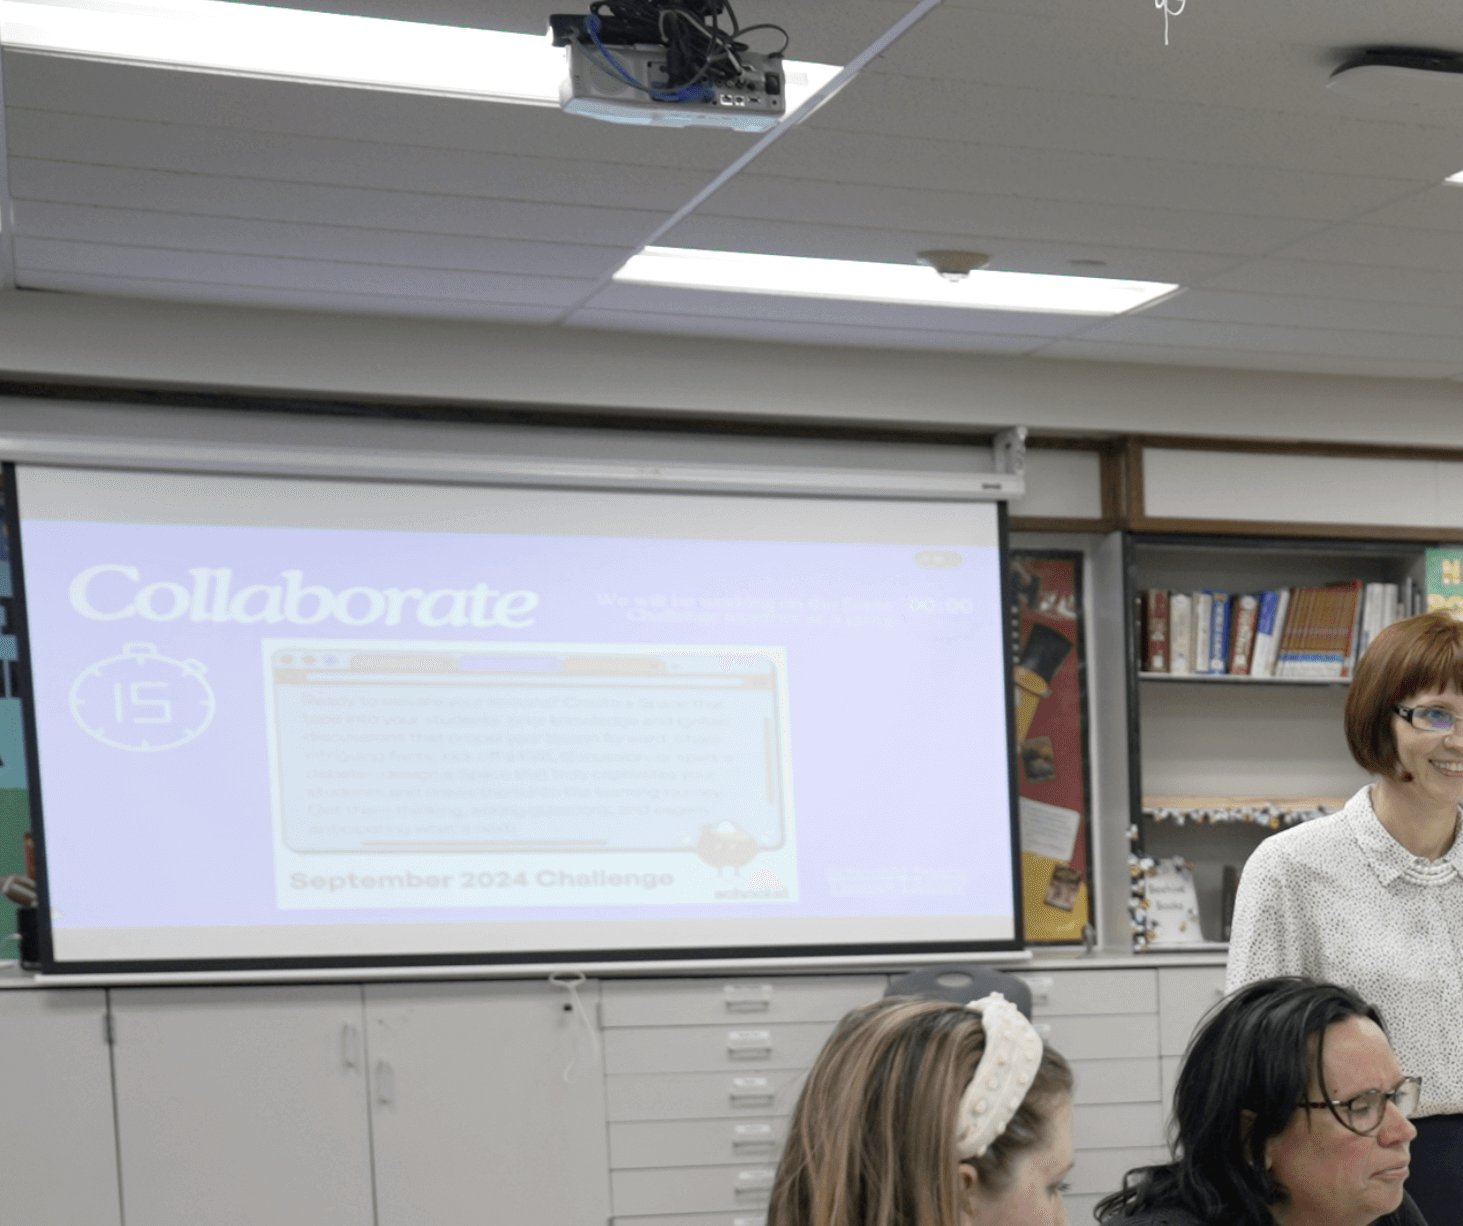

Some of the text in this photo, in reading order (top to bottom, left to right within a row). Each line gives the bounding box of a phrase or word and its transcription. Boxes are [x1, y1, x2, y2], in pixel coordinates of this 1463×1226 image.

[68, 563, 540, 628] Collaborate
[113, 681, 172, 726] 15
[289, 867, 675, 893] September 2024 Challenge
